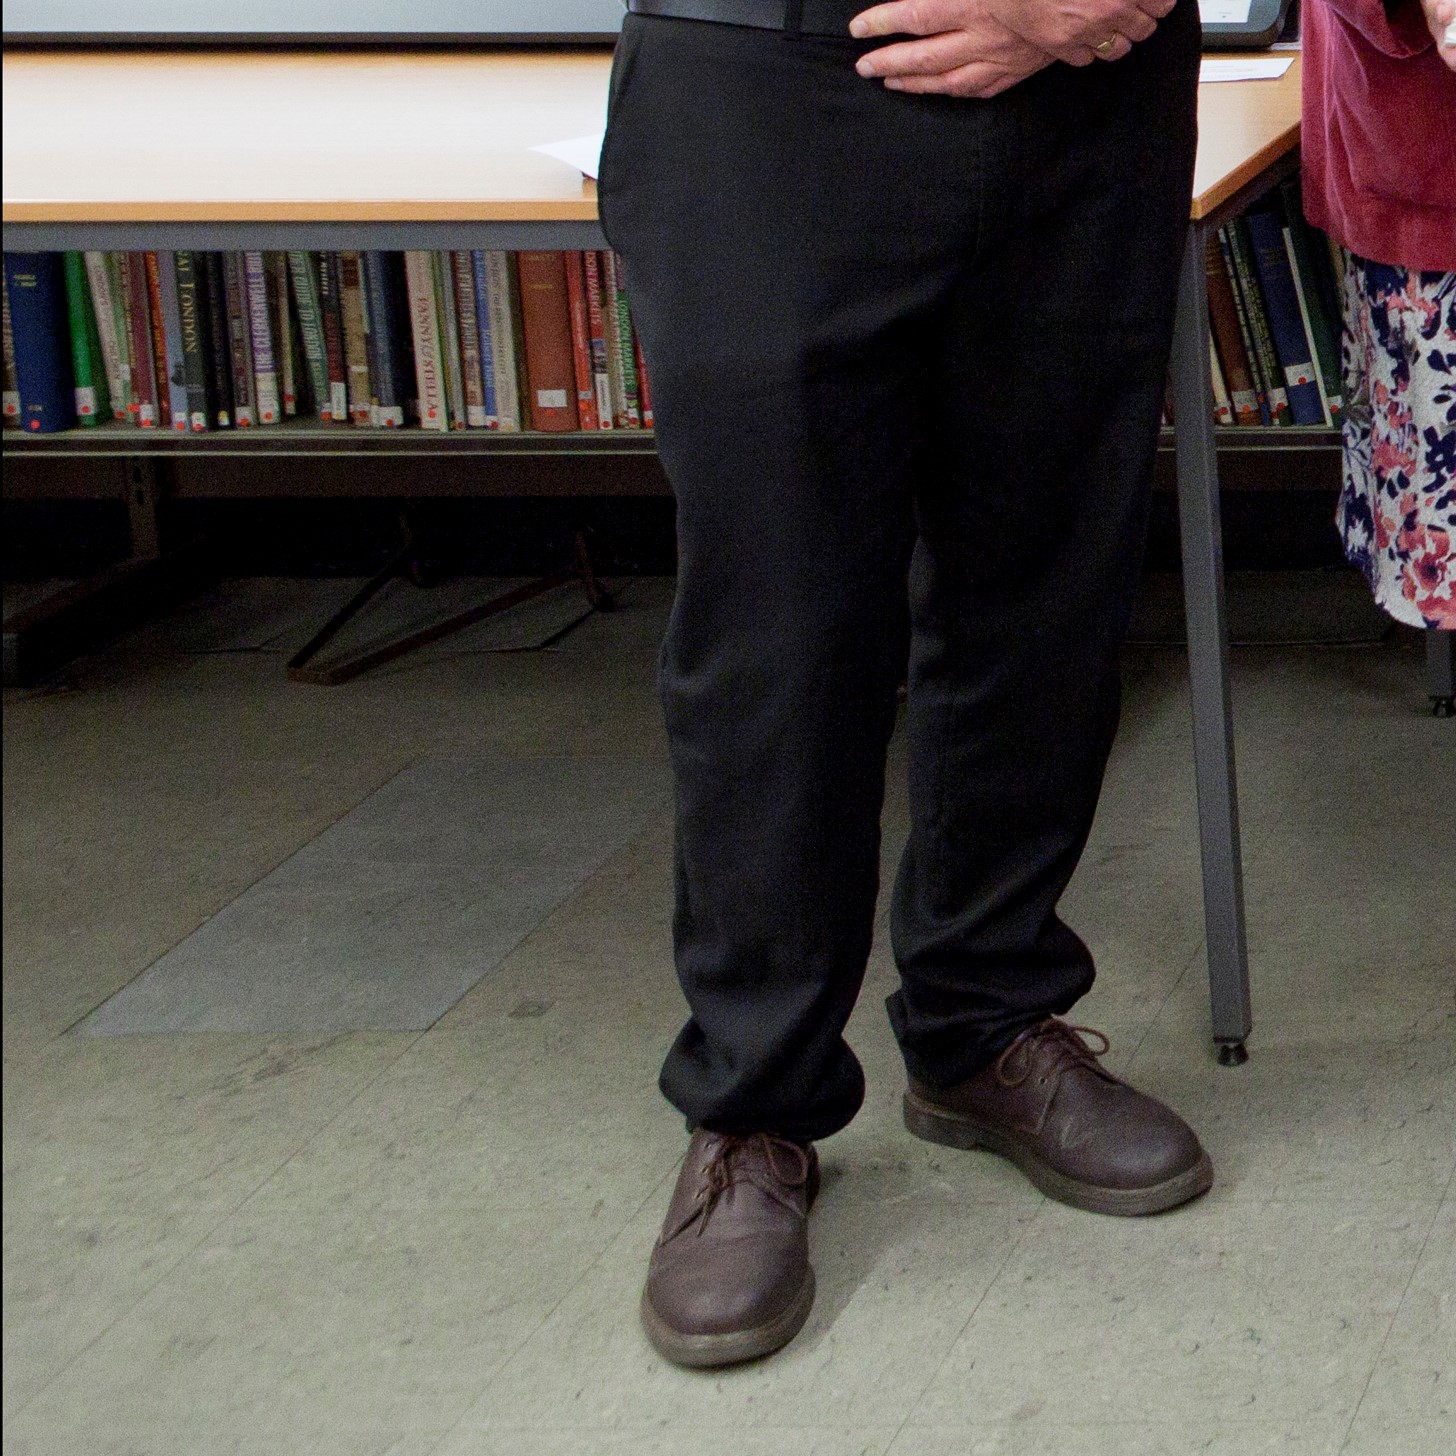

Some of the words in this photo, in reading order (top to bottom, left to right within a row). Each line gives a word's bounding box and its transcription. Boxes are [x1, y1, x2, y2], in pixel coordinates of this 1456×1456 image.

[181, 283, 198, 352] LONDON
[619, 300, 630, 340] LONDON
[622, 342, 635, 385] MARKETS
